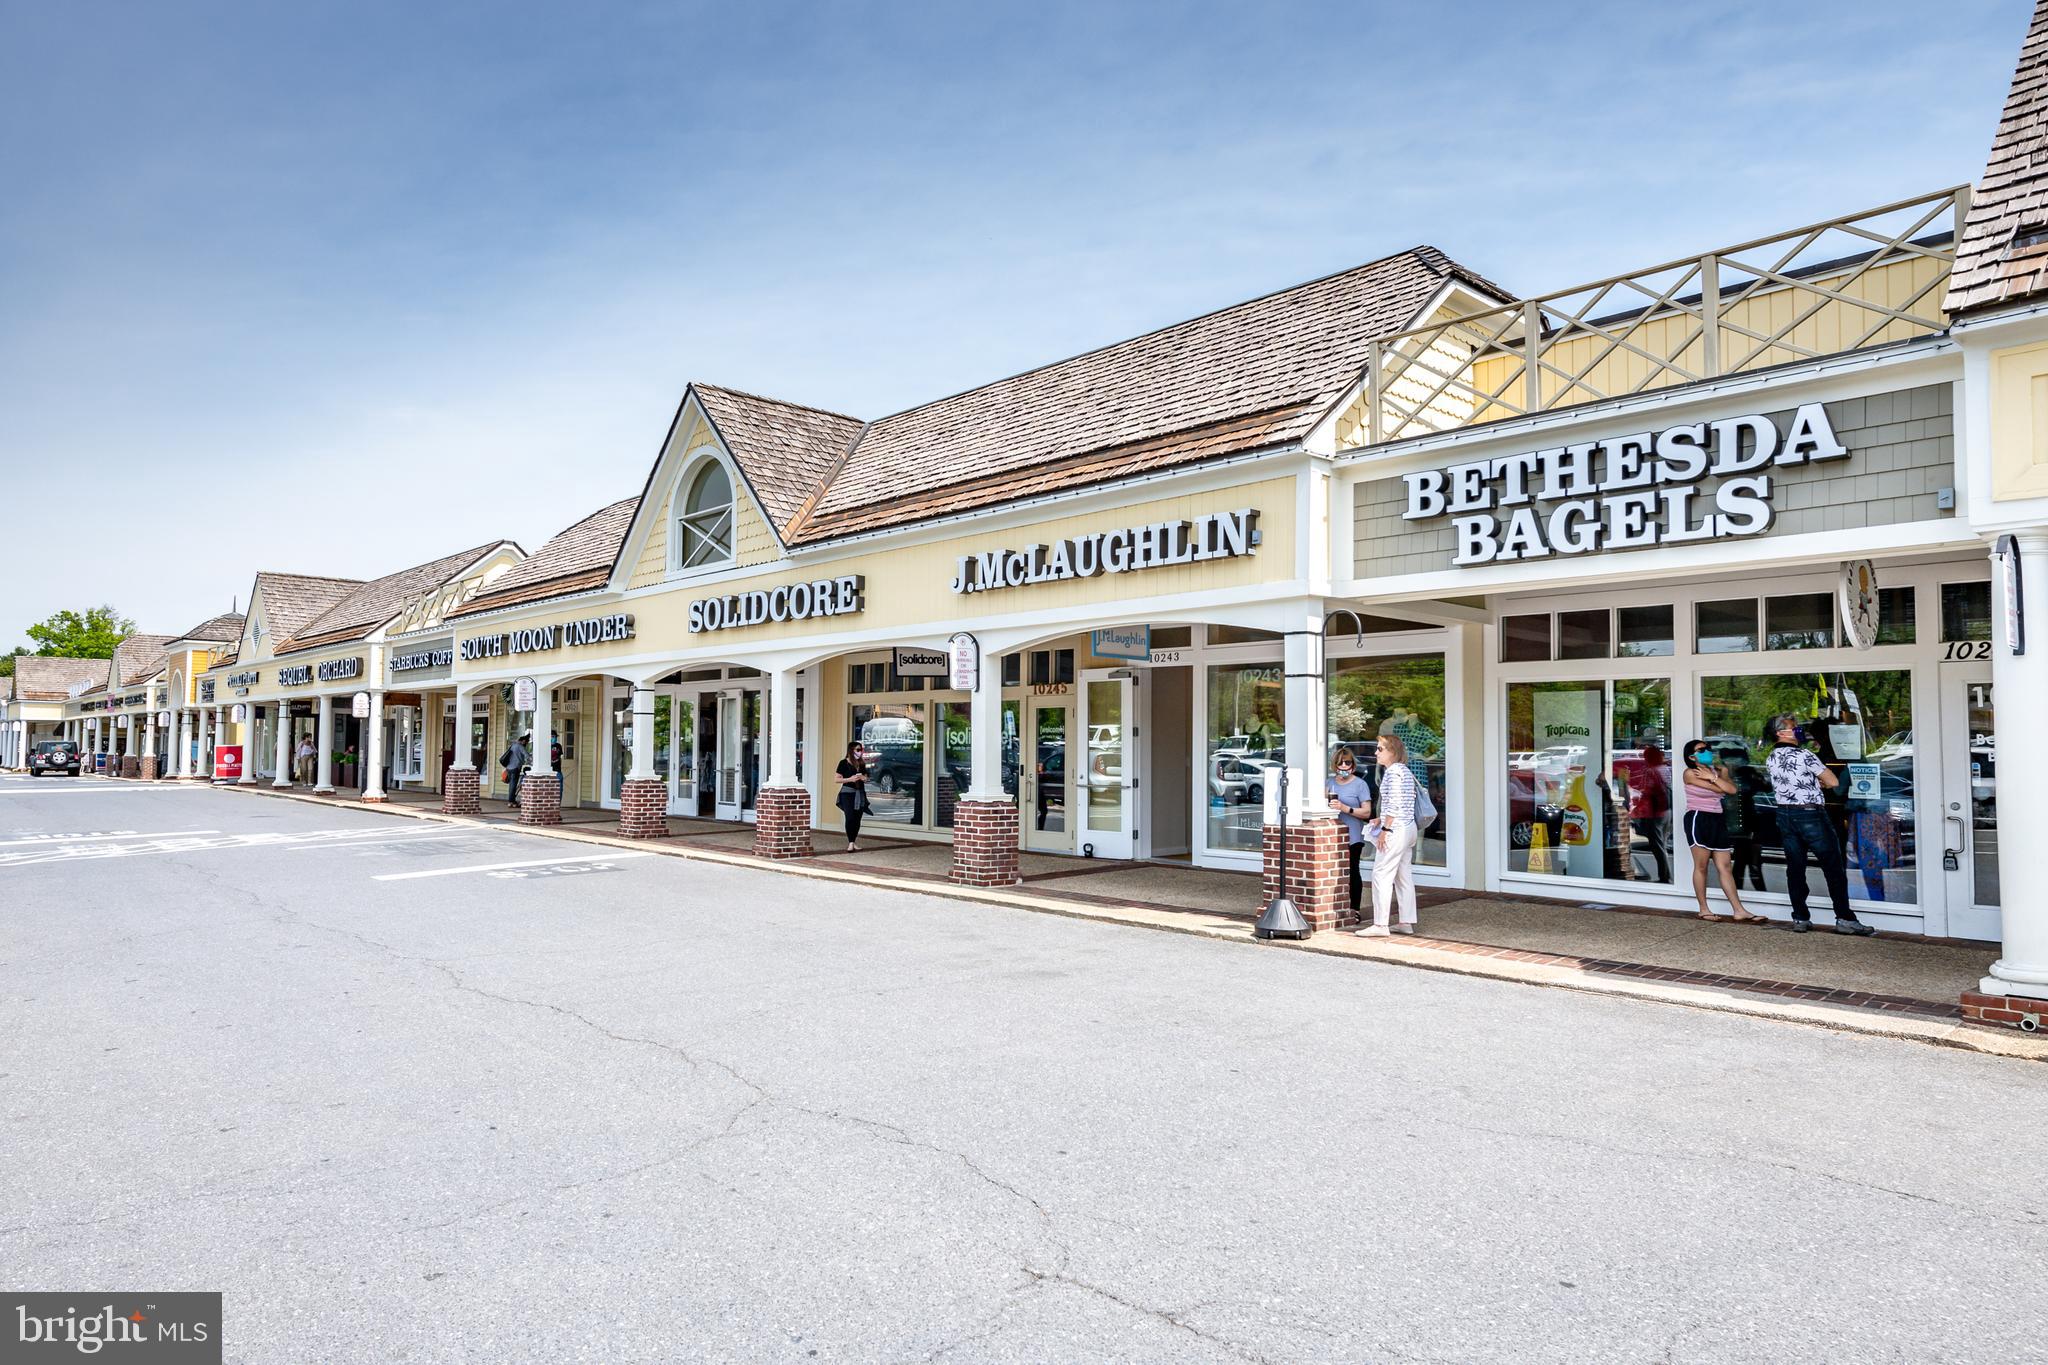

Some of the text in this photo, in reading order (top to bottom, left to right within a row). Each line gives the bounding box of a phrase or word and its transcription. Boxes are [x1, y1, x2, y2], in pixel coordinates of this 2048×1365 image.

[1402, 402, 1848, 520] BETHESDA
[1452, 476, 1773, 565] BAGELS
[688, 575, 858, 633] SOLIDCORE
[460, 614, 629, 660] SOUTH MOON UNDER
[389, 650, 453, 671] STARBUCKS COFF
[1149, 652, 1180, 663] 10243
[1944, 641, 1992, 660] 102
[279, 665, 311, 686] SEQUEL
[318, 656, 359, 681] ORCHARD
[1033, 683, 1067, 696] 10245
[1545, 723, 1590, 737] Tropicana
